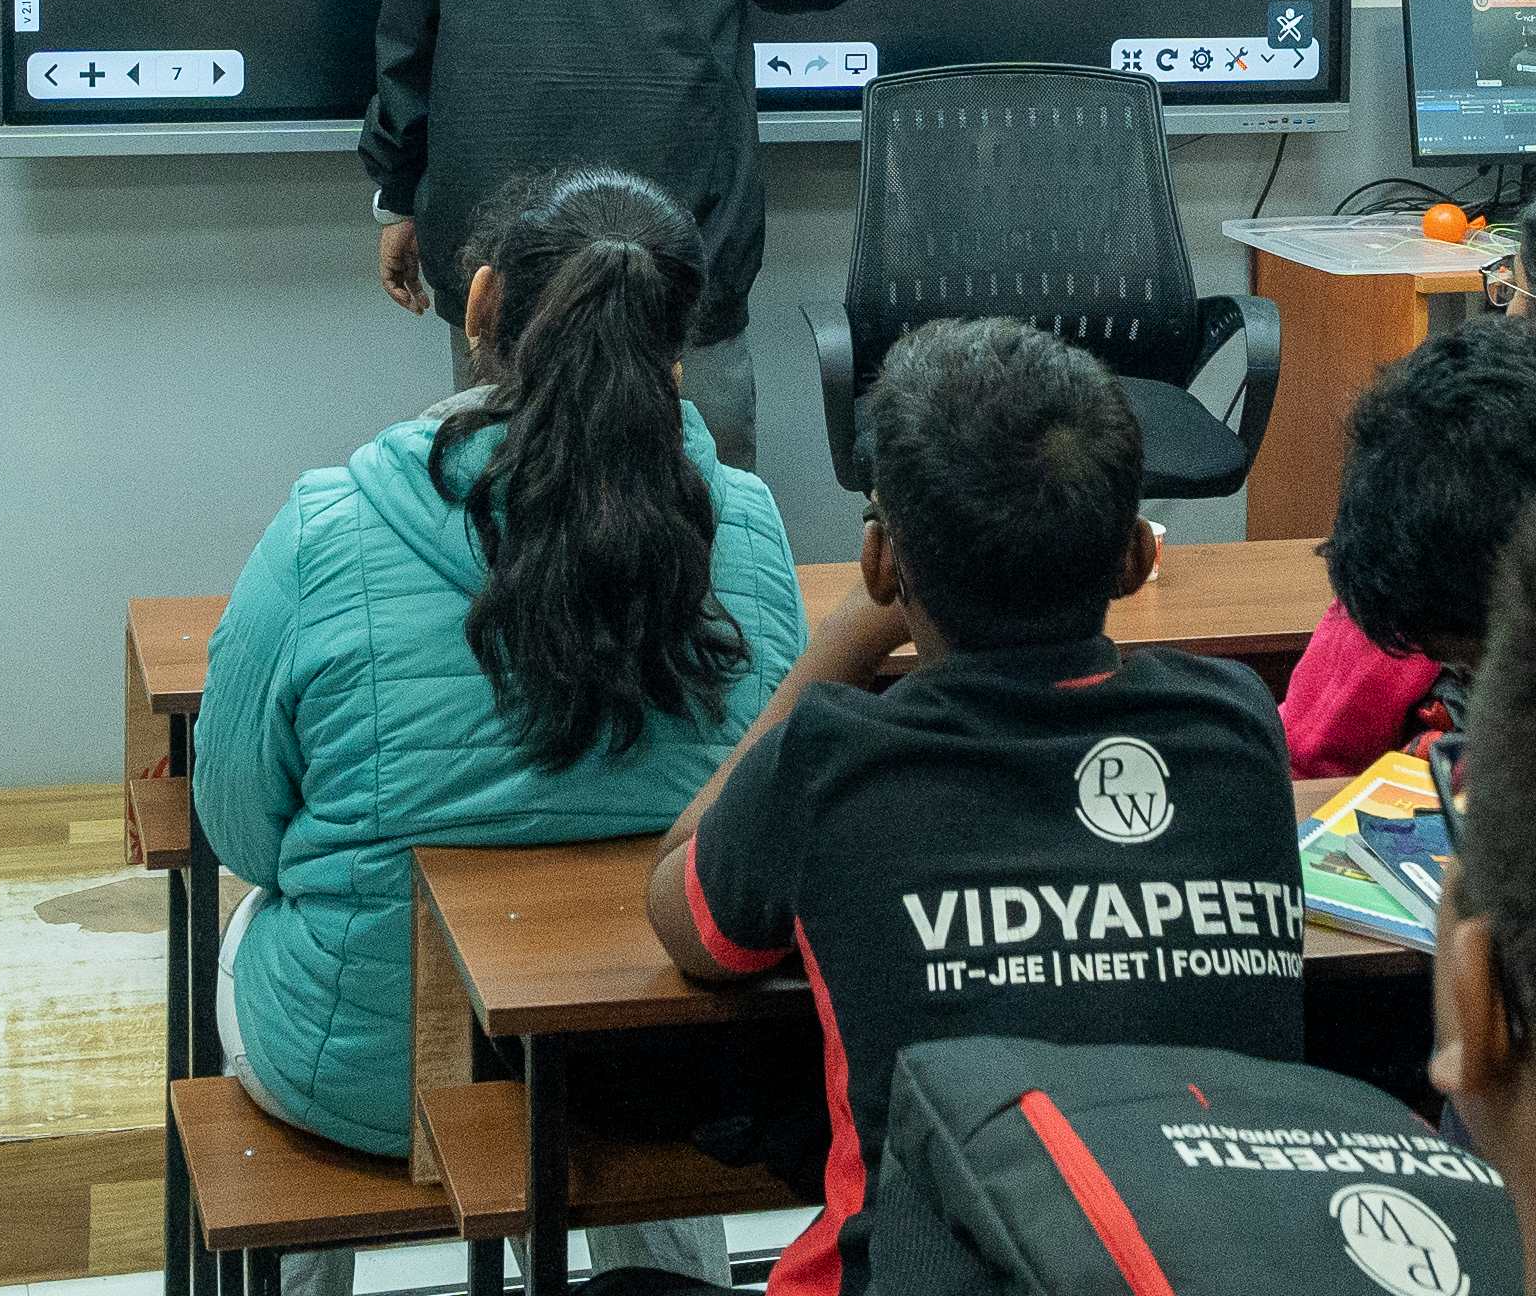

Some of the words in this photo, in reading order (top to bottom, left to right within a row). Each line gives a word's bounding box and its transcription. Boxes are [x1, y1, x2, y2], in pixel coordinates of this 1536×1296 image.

[172, 67, 183, 81] 7
[902, 879, 1304, 952] VIDYAPEETH
[925, 954, 1046, 993] IIT-JEE
[1069, 950, 1150, 983] NEET
[1161, 1123, 1326, 1146] FOUNDATION
